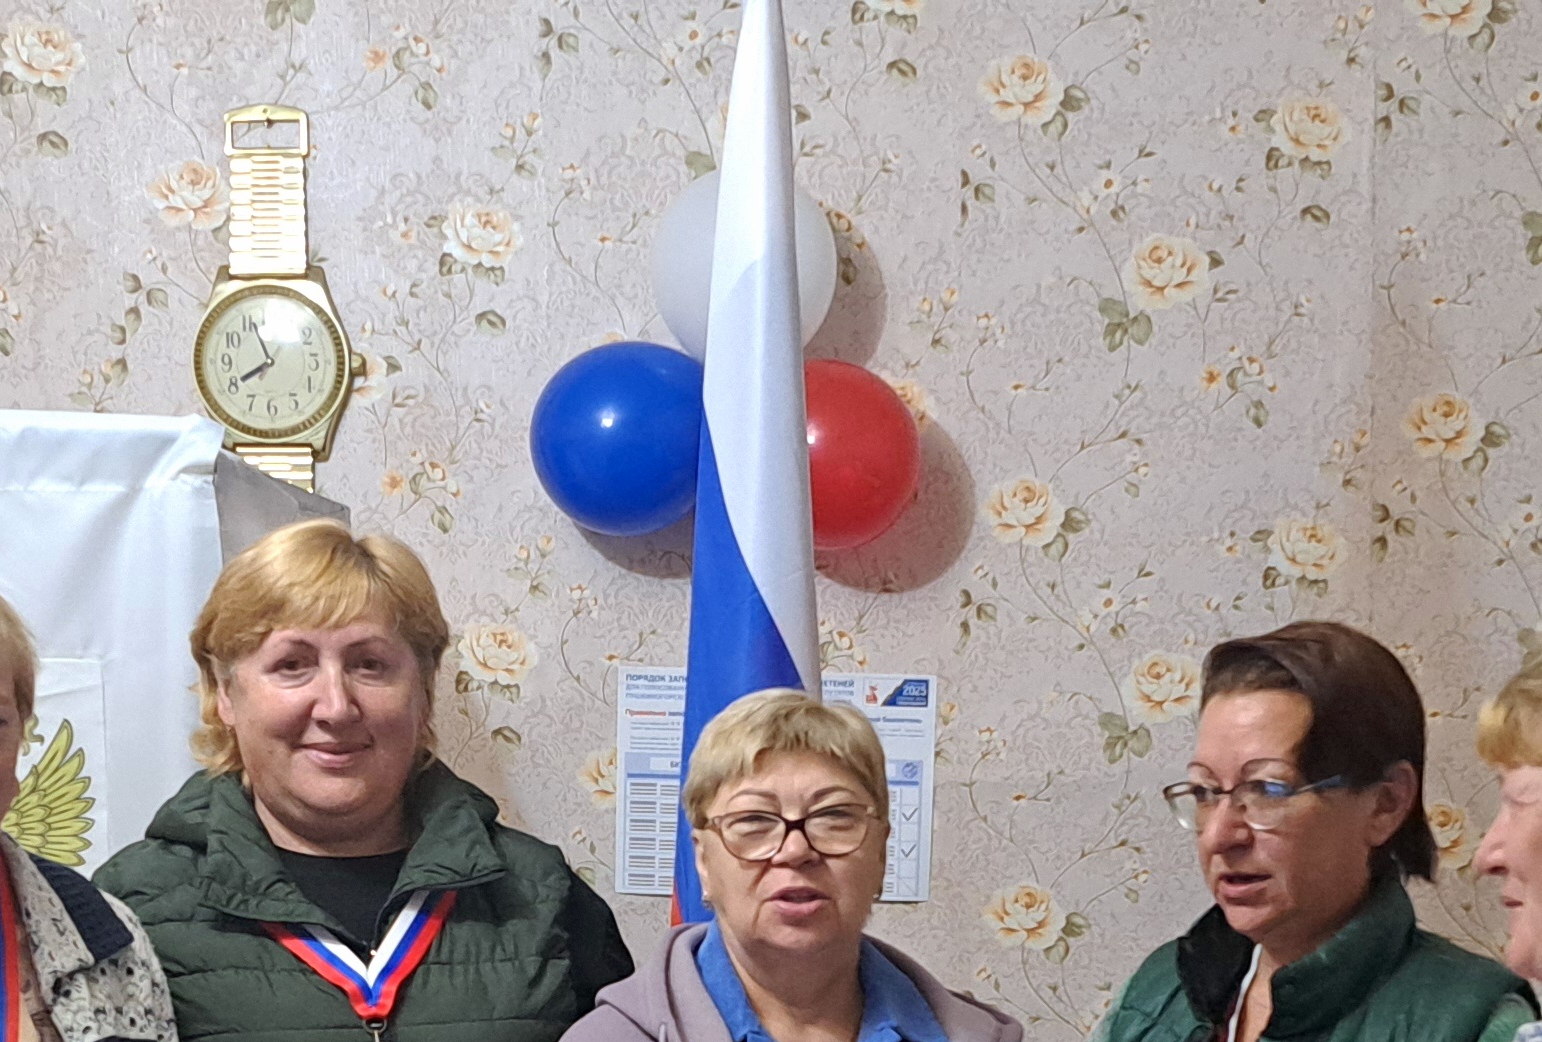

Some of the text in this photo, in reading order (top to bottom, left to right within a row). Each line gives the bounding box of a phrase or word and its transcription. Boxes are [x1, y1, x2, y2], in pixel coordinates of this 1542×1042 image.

[225, 331, 241, 349] 10
[302, 326, 312, 345] 2
[221, 353, 232, 373] 9
[308, 353, 319, 371] 3
[228, 376, 239, 394] 8
[246, 394, 256, 412] 7
[267, 399, 278, 417] 6
[288, 392, 299, 411] 5
